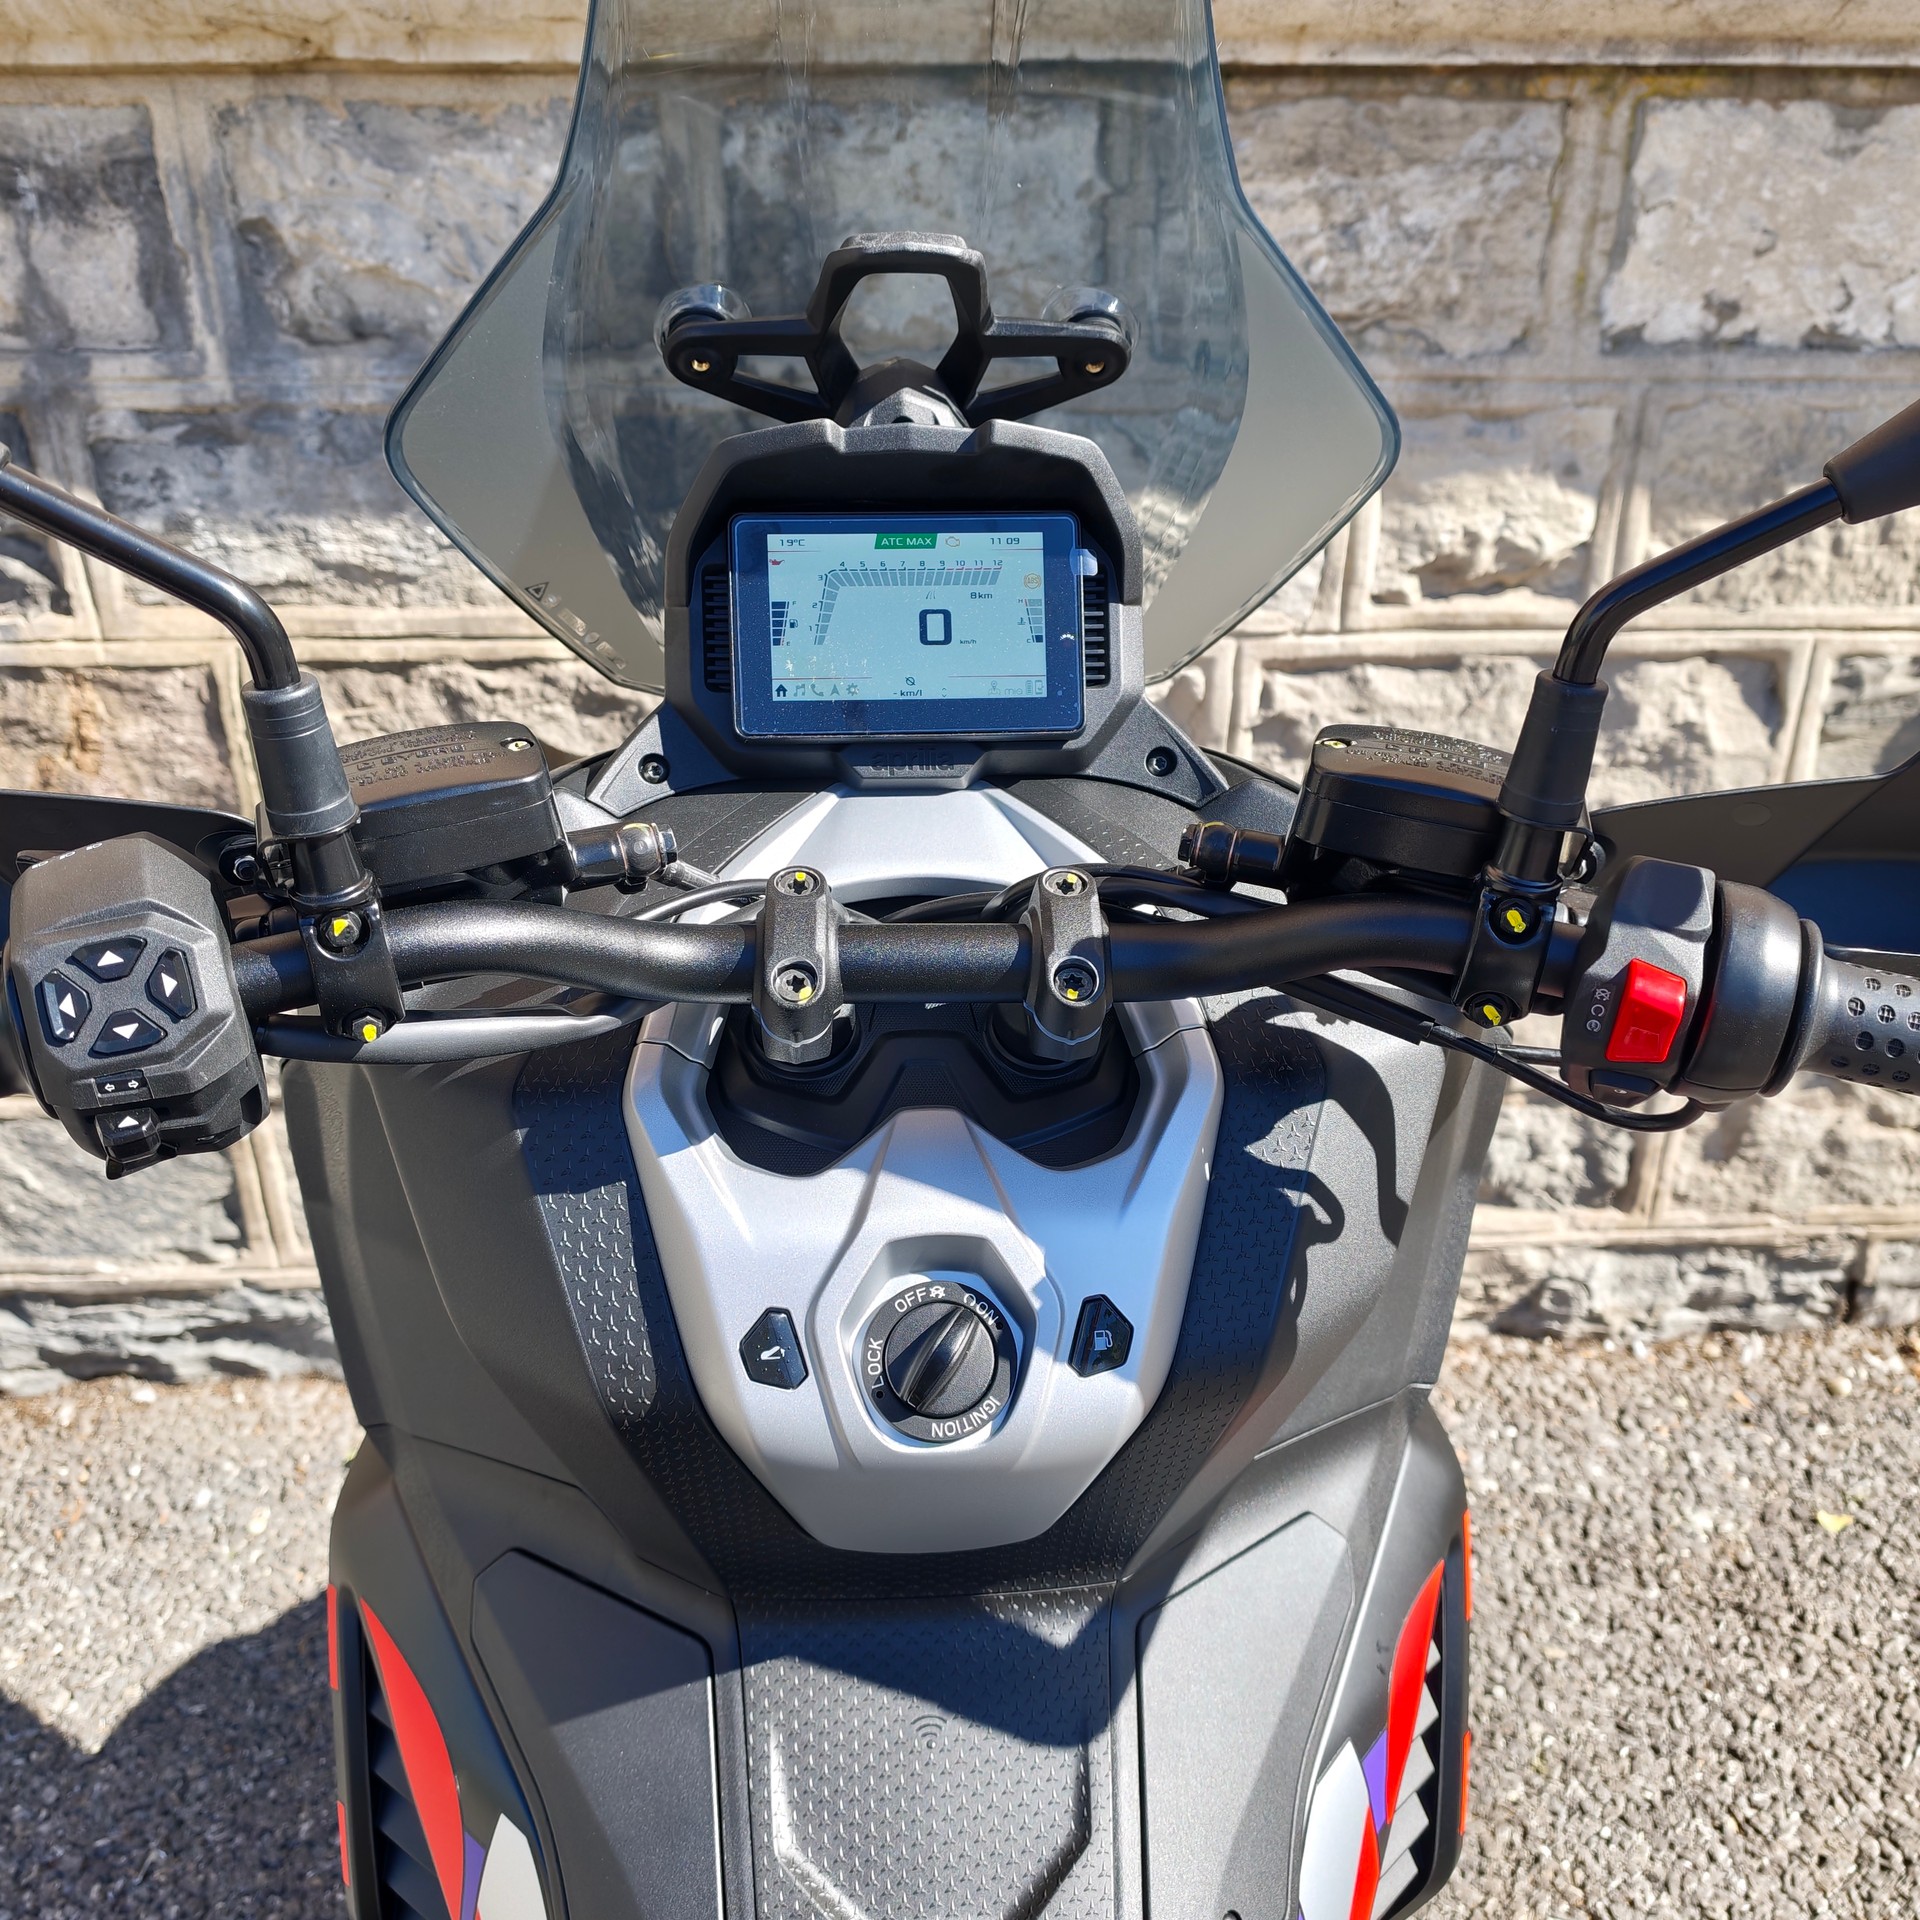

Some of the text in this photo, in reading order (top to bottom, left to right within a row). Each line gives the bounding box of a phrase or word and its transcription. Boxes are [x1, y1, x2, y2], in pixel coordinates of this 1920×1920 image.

[881, 537, 932, 546] ATC MAX
[919, 609, 952, 645] 0
[894, 1287, 927, 1313] OFF
[975, 1301, 999, 1326] ON
[867, 1337, 885, 1389] LOCK
[931, 1395, 1002, 1438] IGNITION
